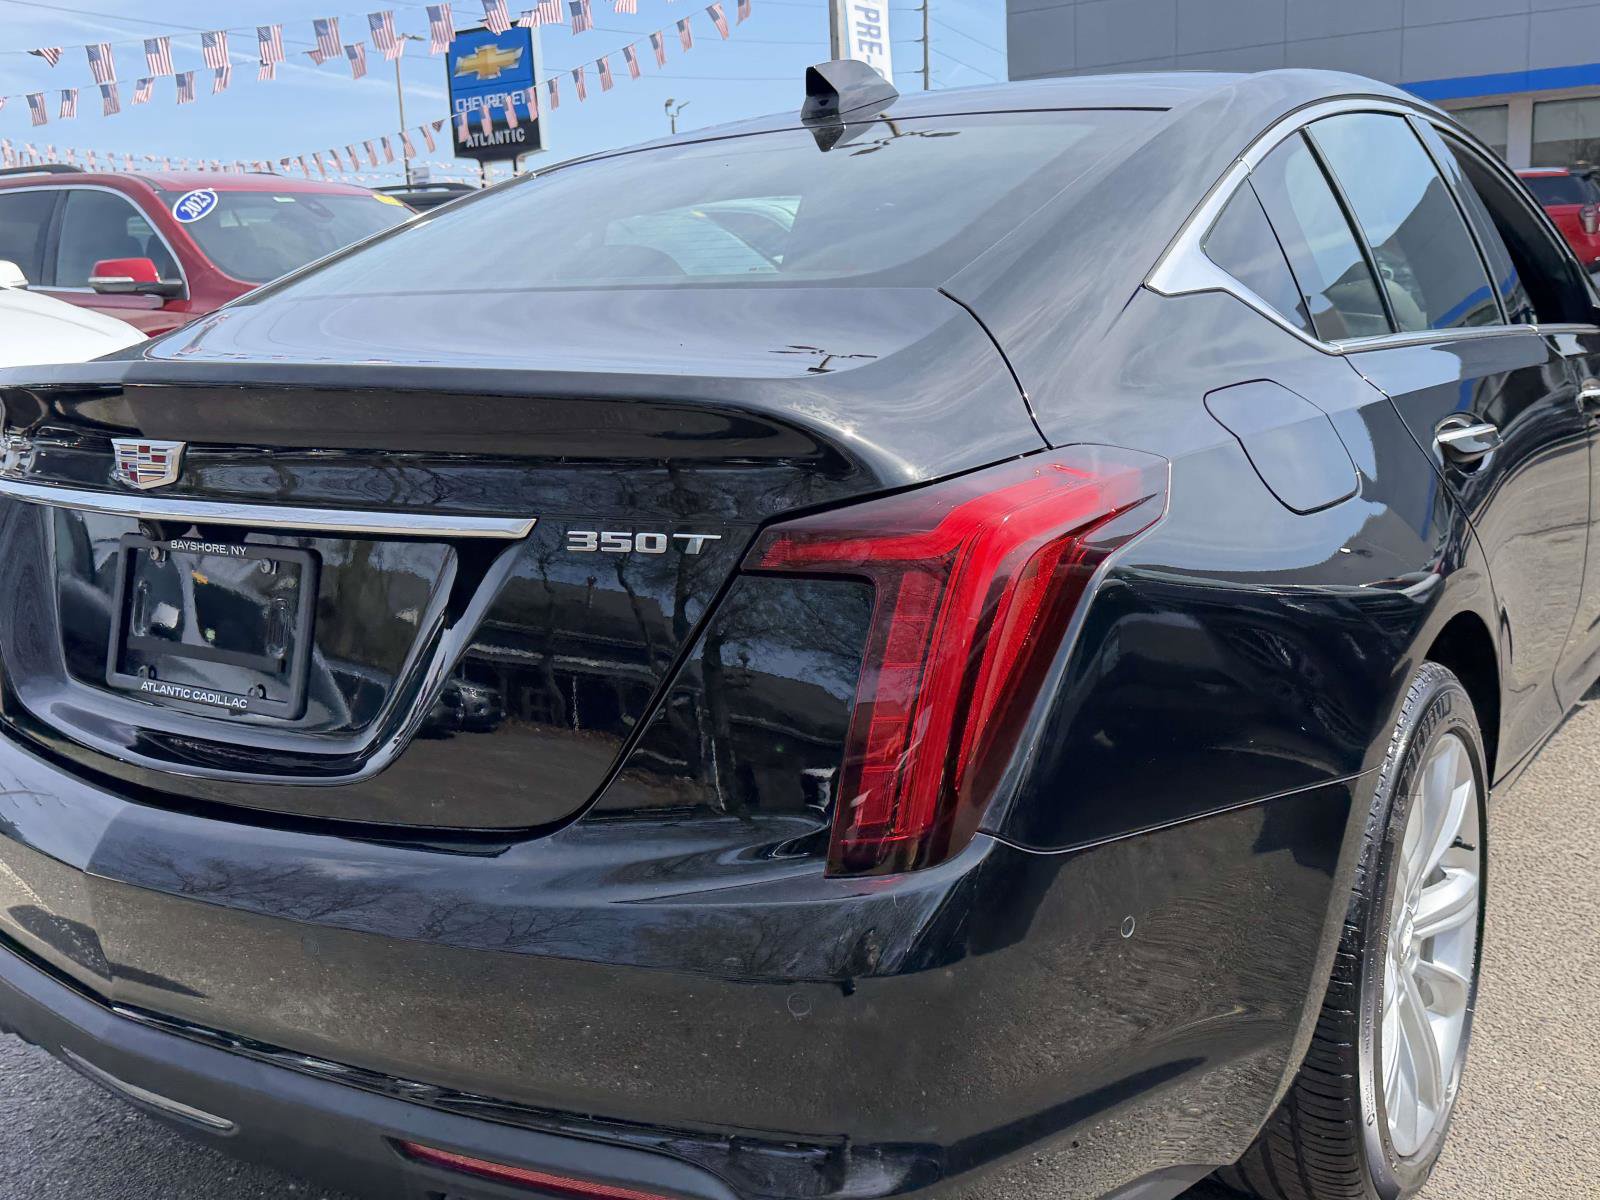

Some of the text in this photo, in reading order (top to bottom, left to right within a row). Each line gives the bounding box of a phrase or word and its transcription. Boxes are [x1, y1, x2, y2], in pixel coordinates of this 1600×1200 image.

[466, 128, 526, 148] ATLANTIC
[180, 192, 212, 219] 2023
[170, 540, 247, 556] BAYSHORE, NY
[140, 681, 248, 709] ATLANTIC CADILLAC
